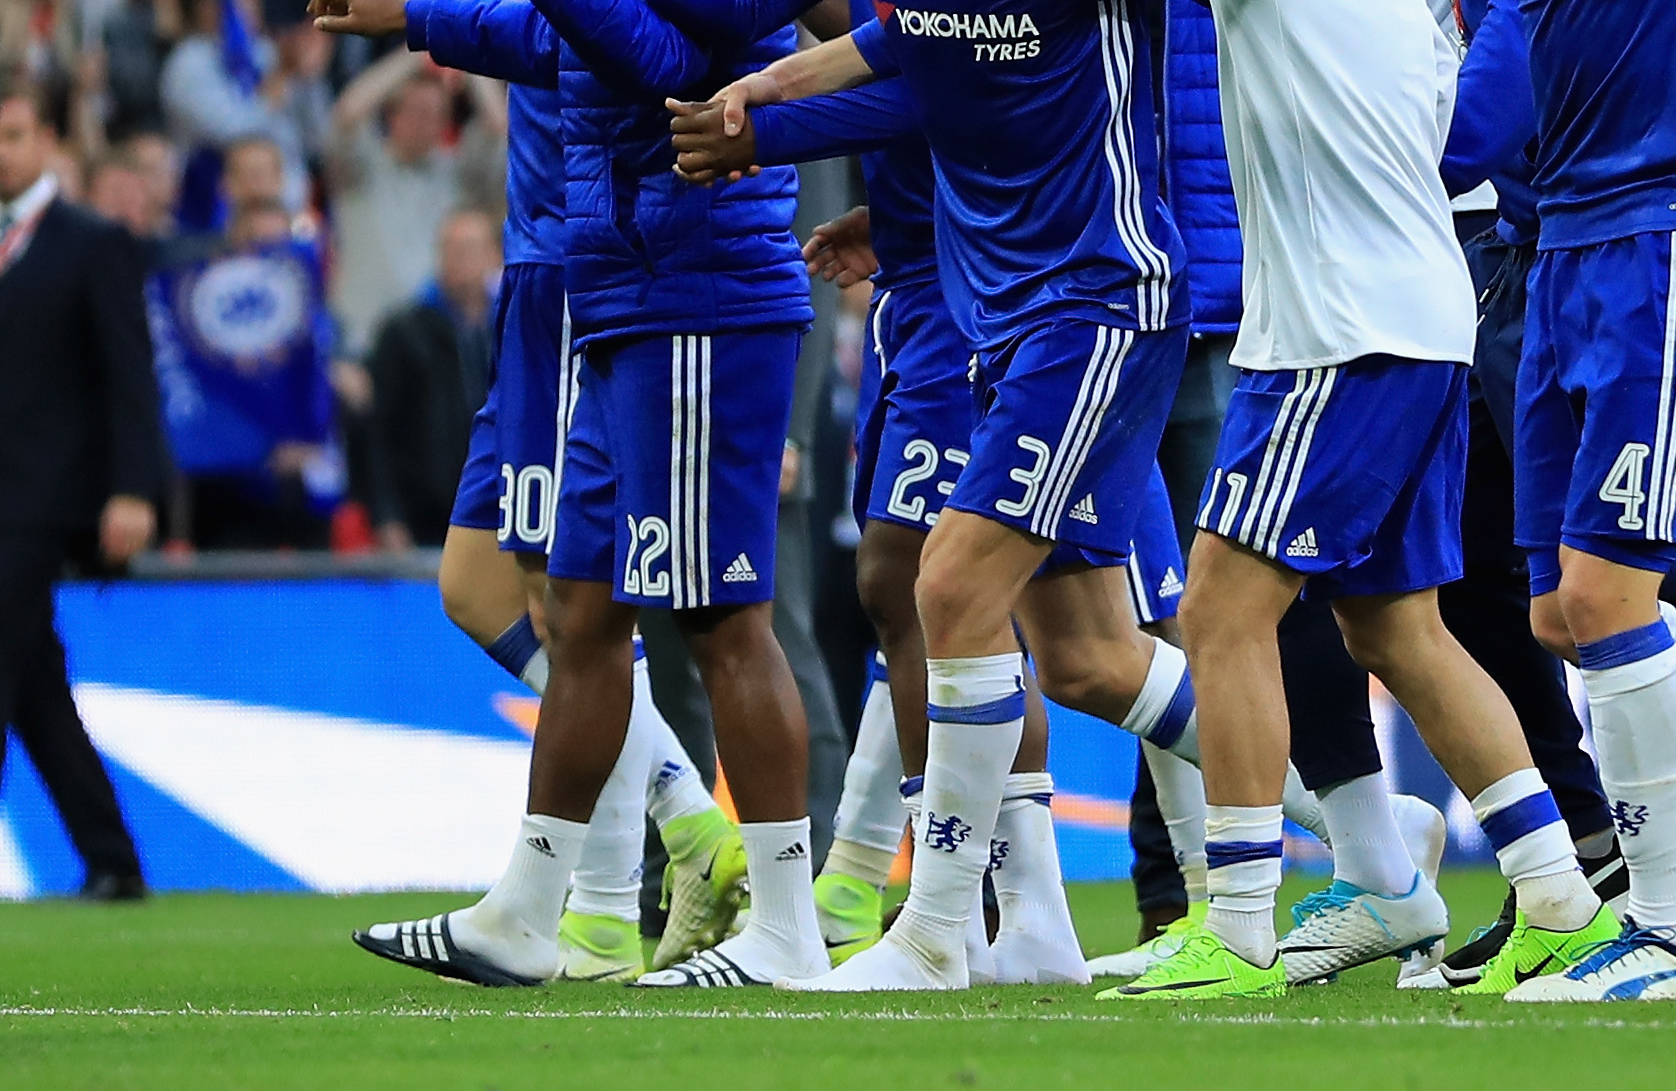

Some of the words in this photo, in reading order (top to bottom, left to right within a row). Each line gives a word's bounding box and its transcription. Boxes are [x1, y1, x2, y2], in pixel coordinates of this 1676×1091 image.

[895, 7, 1040, 39] YOKOHAMA
[973, 39, 1041, 61] TYRES
[995, 434, 1051, 517] 3
[1598, 442, 1650, 531] 4
[1068, 509, 1098, 525] adidas
[1286, 546, 1319, 557] adidas
[722, 571, 758, 583] adidas
